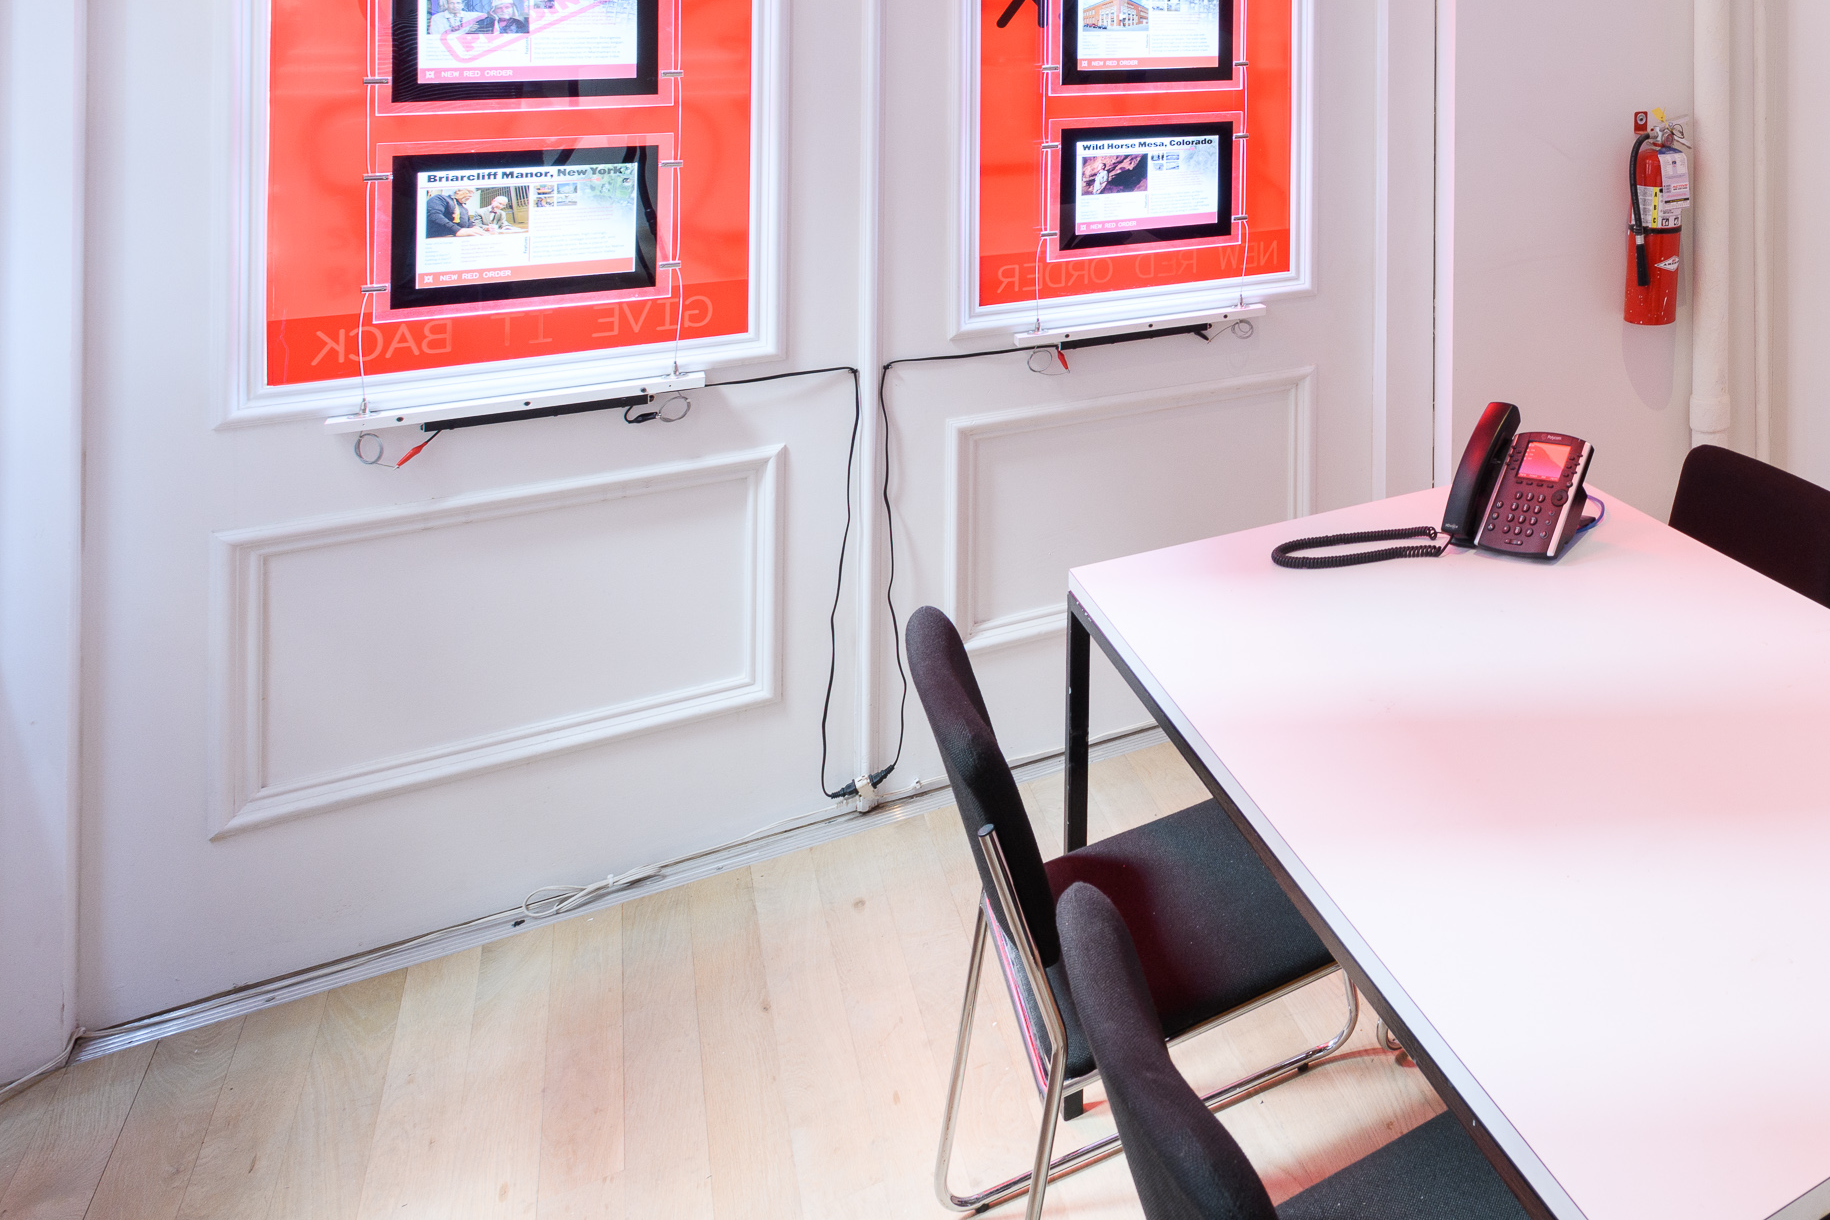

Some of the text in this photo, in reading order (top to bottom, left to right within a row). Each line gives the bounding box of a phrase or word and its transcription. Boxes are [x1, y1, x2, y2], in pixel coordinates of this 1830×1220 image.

[441, 70, 460, 78] NEW
[484, 69, 513, 77] ORDER
[1082, 143, 1105, 151] Wild
[1107, 142, 1136, 150] Horse
[1169, 138, 1213, 146] Colorado
[427, 166, 622, 183] Briarcliff Manor, New York
[462, 272, 479, 280] RED
[483, 270, 511, 278] ORDER
